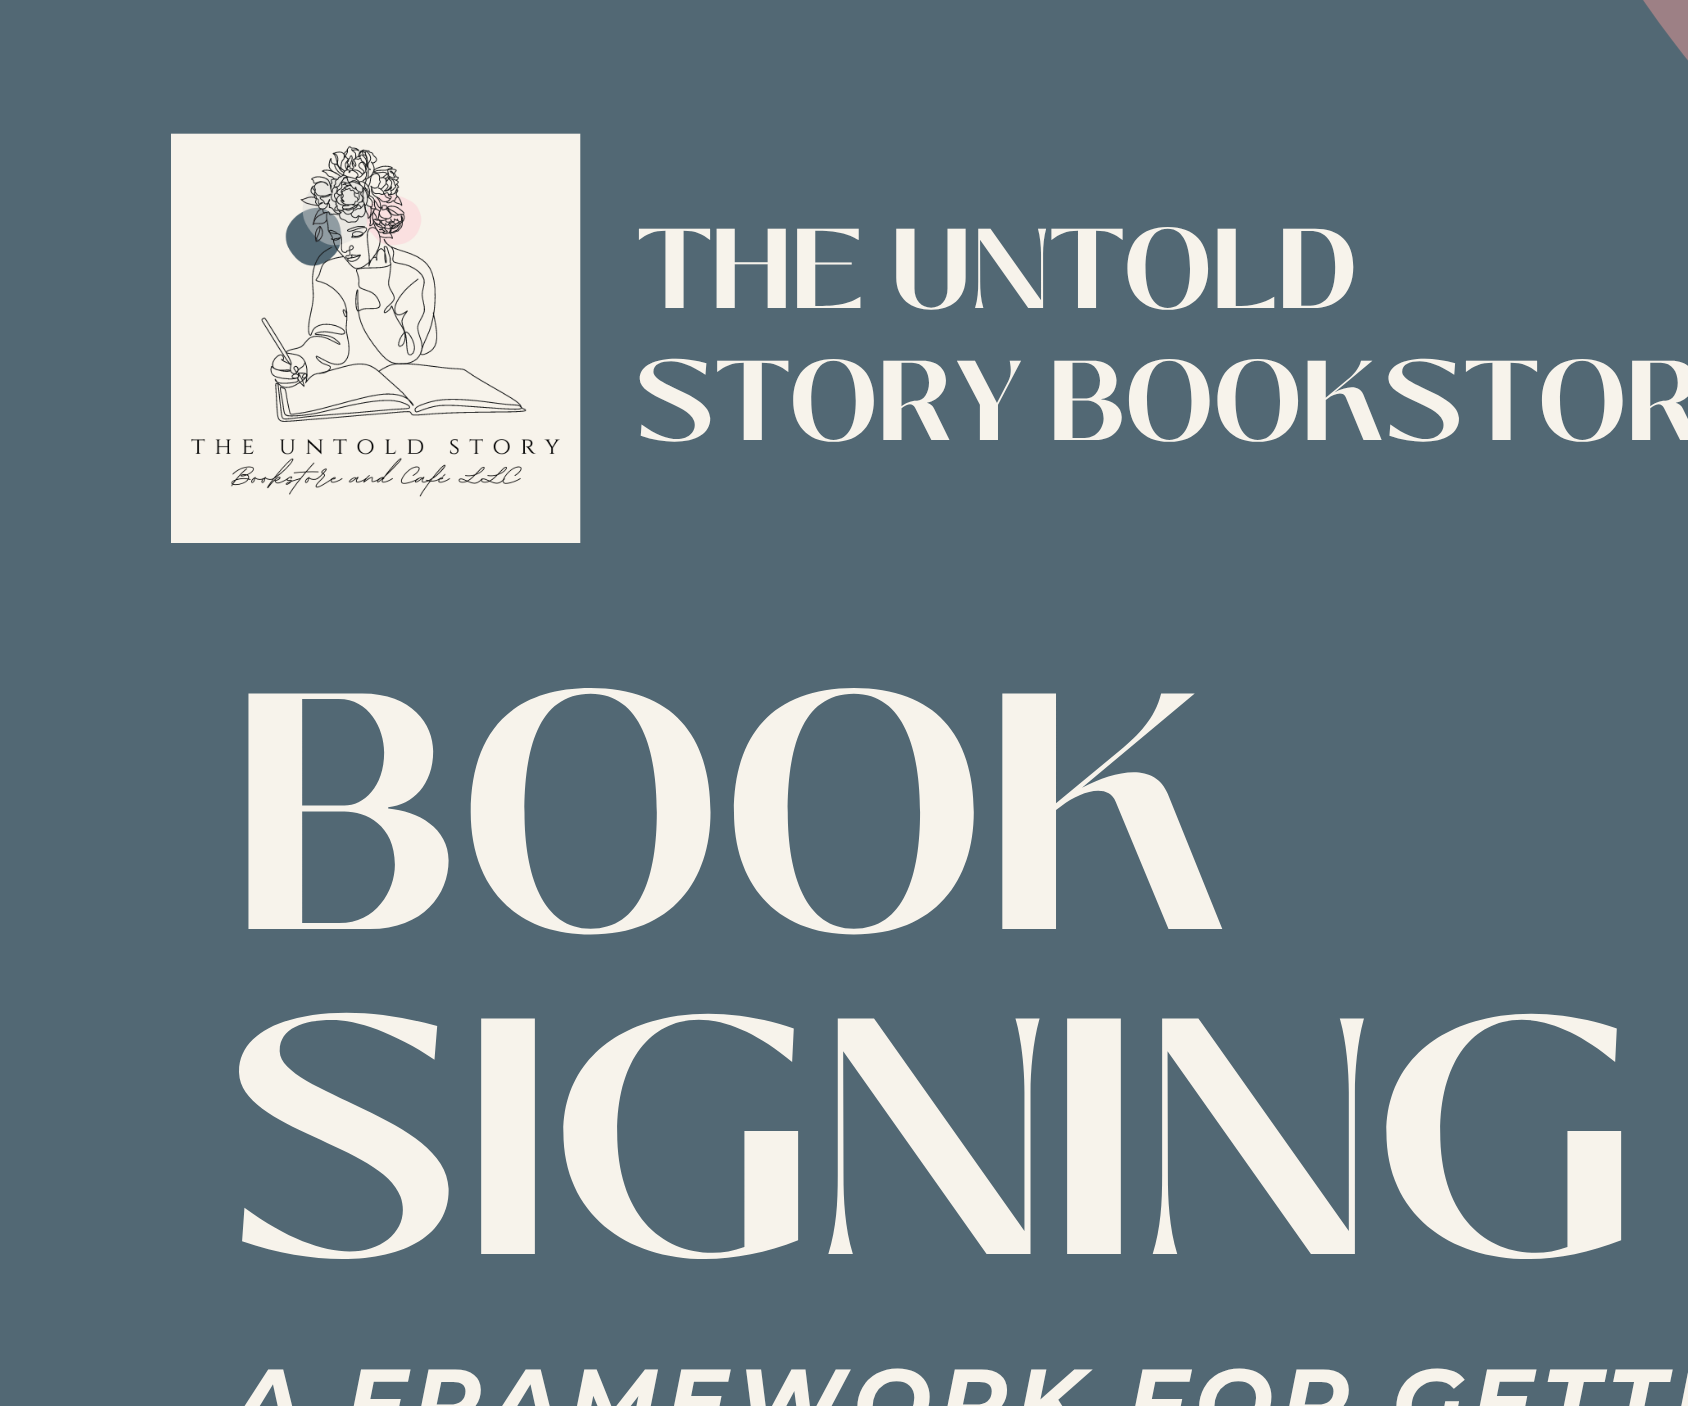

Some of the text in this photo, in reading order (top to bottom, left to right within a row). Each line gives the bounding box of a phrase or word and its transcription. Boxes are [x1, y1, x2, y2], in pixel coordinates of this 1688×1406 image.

[639, 227, 1354, 310] THE UNTOLD
[639, 358, 1021, 442] STORY
[191, 438, 560, 455] THE UNTOLD STORY
[231, 458, 343, 495] Bookstore
[349, 457, 402, 483] and
[458, 466, 523, 485] LLC
[248, 688, 1222, 935] BOOK
[239, 1012, 1621, 1259] SIGNING
